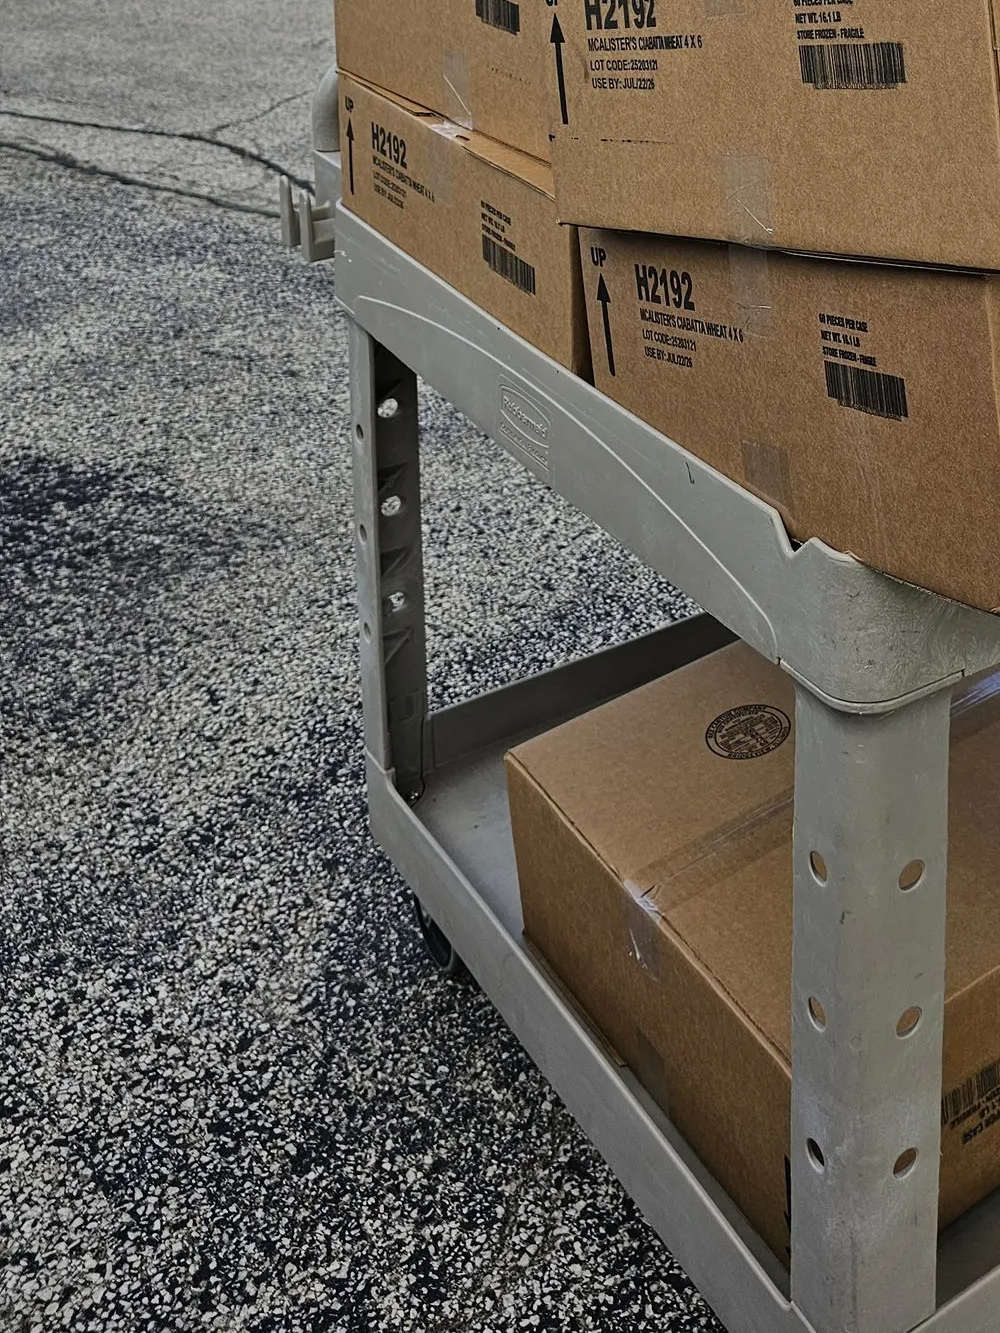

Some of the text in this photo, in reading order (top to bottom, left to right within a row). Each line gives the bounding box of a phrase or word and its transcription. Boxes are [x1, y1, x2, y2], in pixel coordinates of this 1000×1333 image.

[795, 11, 841, 24] NET WT. 16.1 LB
[588, 37, 637, 52] MCALISTER'S
[689, 35, 696, 48] X
[697, 34, 703, 49] 6
[590, 59, 604, 71] LOT
[592, 77, 607, 89] USE
[345, 96, 353, 113] UP
[370, 121, 407, 170] H2192
[591, 247, 606, 267] UP
[633, 263, 695, 312] H2192
